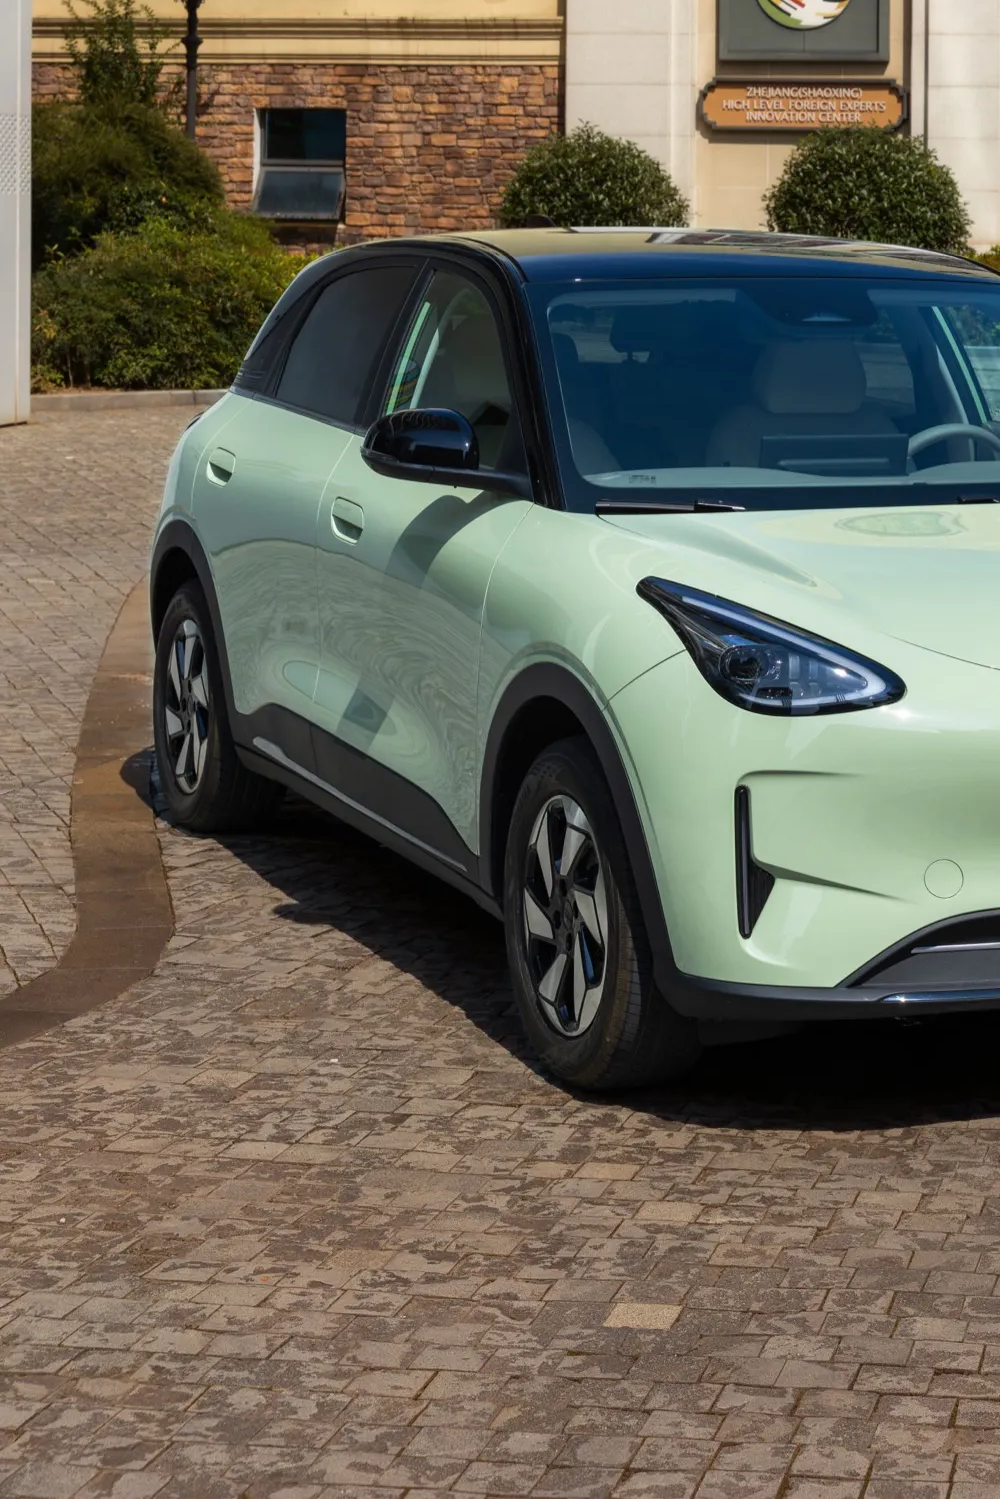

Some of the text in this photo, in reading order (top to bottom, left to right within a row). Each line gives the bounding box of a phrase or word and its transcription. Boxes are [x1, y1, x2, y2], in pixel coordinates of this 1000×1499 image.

[745, 86, 863, 99] ZHEJIANG(SHAOXING)
[722, 99, 887, 112] HIGH LEVEL FOREIGN EXPERTS
[745, 110, 862, 123] INNOVATION CENTER
